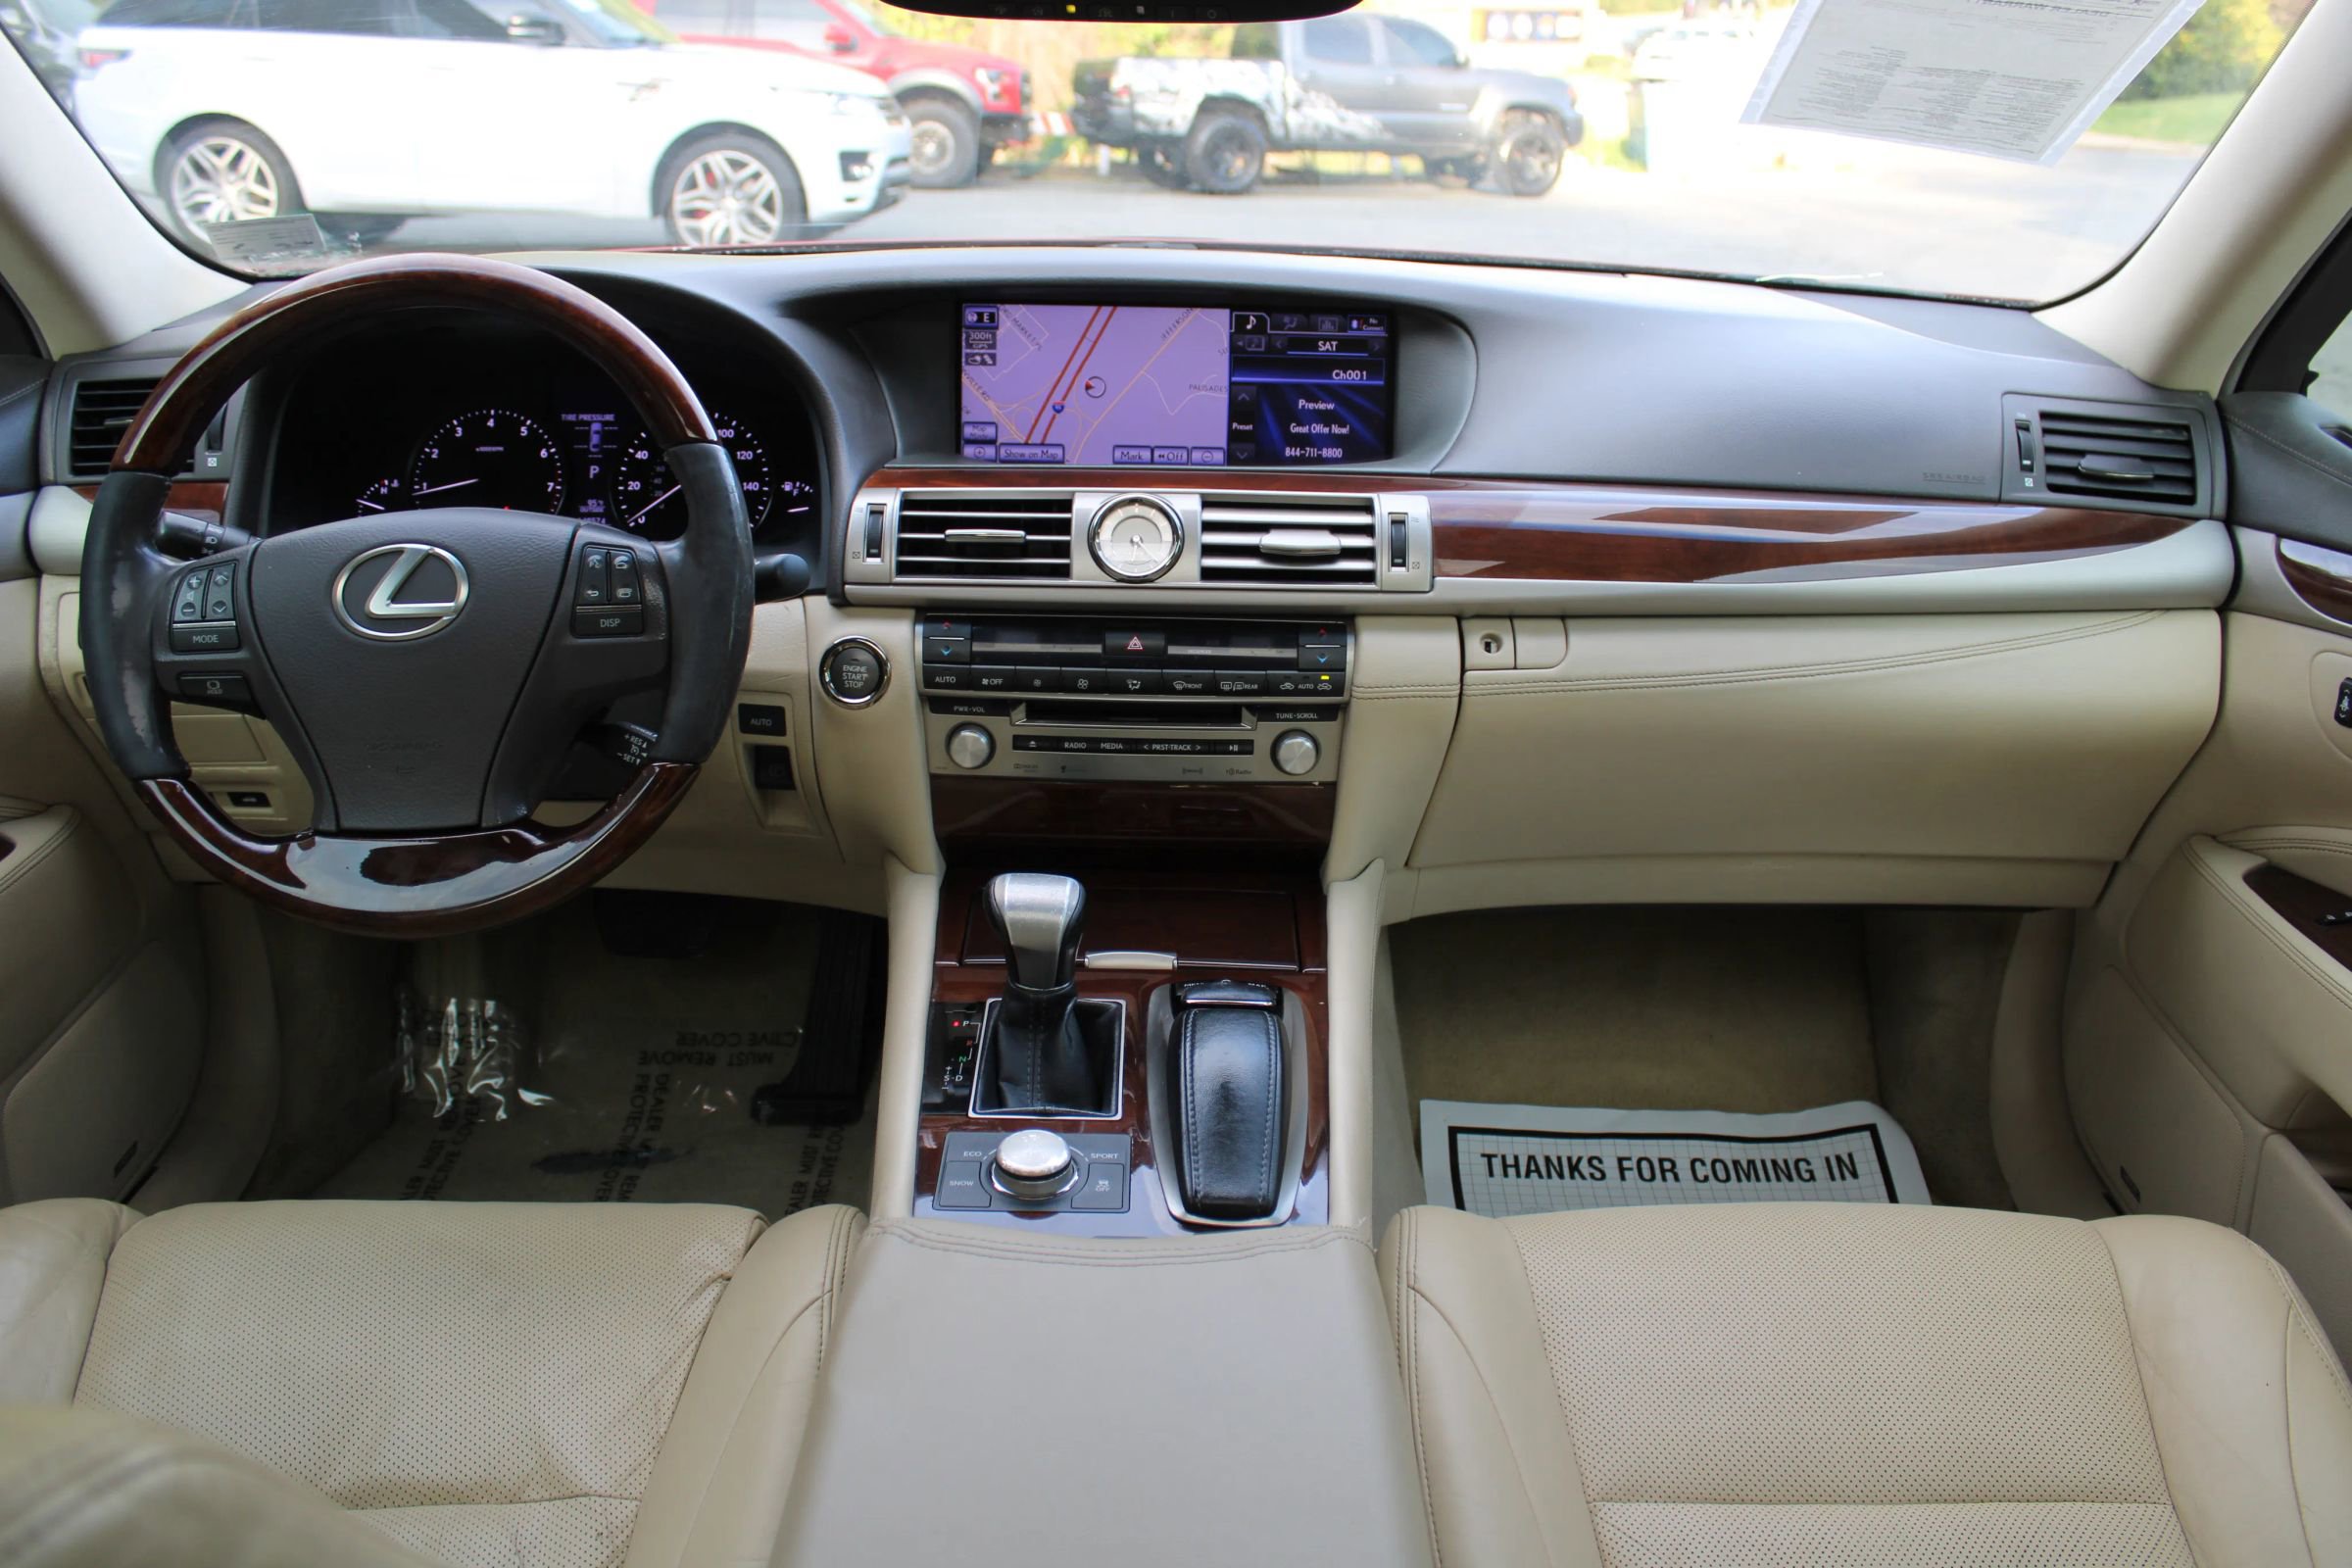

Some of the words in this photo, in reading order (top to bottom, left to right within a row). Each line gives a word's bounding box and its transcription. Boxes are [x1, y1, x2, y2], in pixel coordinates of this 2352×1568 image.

[1317, 341, 1339, 351] SAT
[1332, 369, 1367, 380] Ch001
[1298, 399, 1335, 411] Preview
[487, 418, 495, 427] 4
[1232, 422, 1253, 431] Preset
[455, 427, 463, 437] 3
[520, 426, 528, 436] 5
[1290, 423, 1309, 433] Great
[1311, 423, 1330, 434] Offer
[1332, 424, 1350, 434] Now!
[431, 449, 439, 459] 2
[540, 449, 548, 459] 6
[635, 451, 649, 460] 40
[737, 451, 753, 460] 120
[1004, 449, 1026, 459] Show
[1041, 450, 1058, 460] Map
[1120, 451, 1144, 461] Mark
[1285, 447, 1343, 459] 844-711-8800
[589, 465, 600, 479] P
[547, 482, 555, 492] 7
[627, 481, 641, 490] 20
[743, 482, 760, 491] 140
[600, 618, 620, 628] DISP
[675, 1030, 742, 1048] COVER
[1480, 1152, 1606, 1182] THANKS
[1617, 1154, 1679, 1184] FOR
[1690, 1154, 1815, 1185] COMING
[1825, 1152, 1860, 1181] IN
